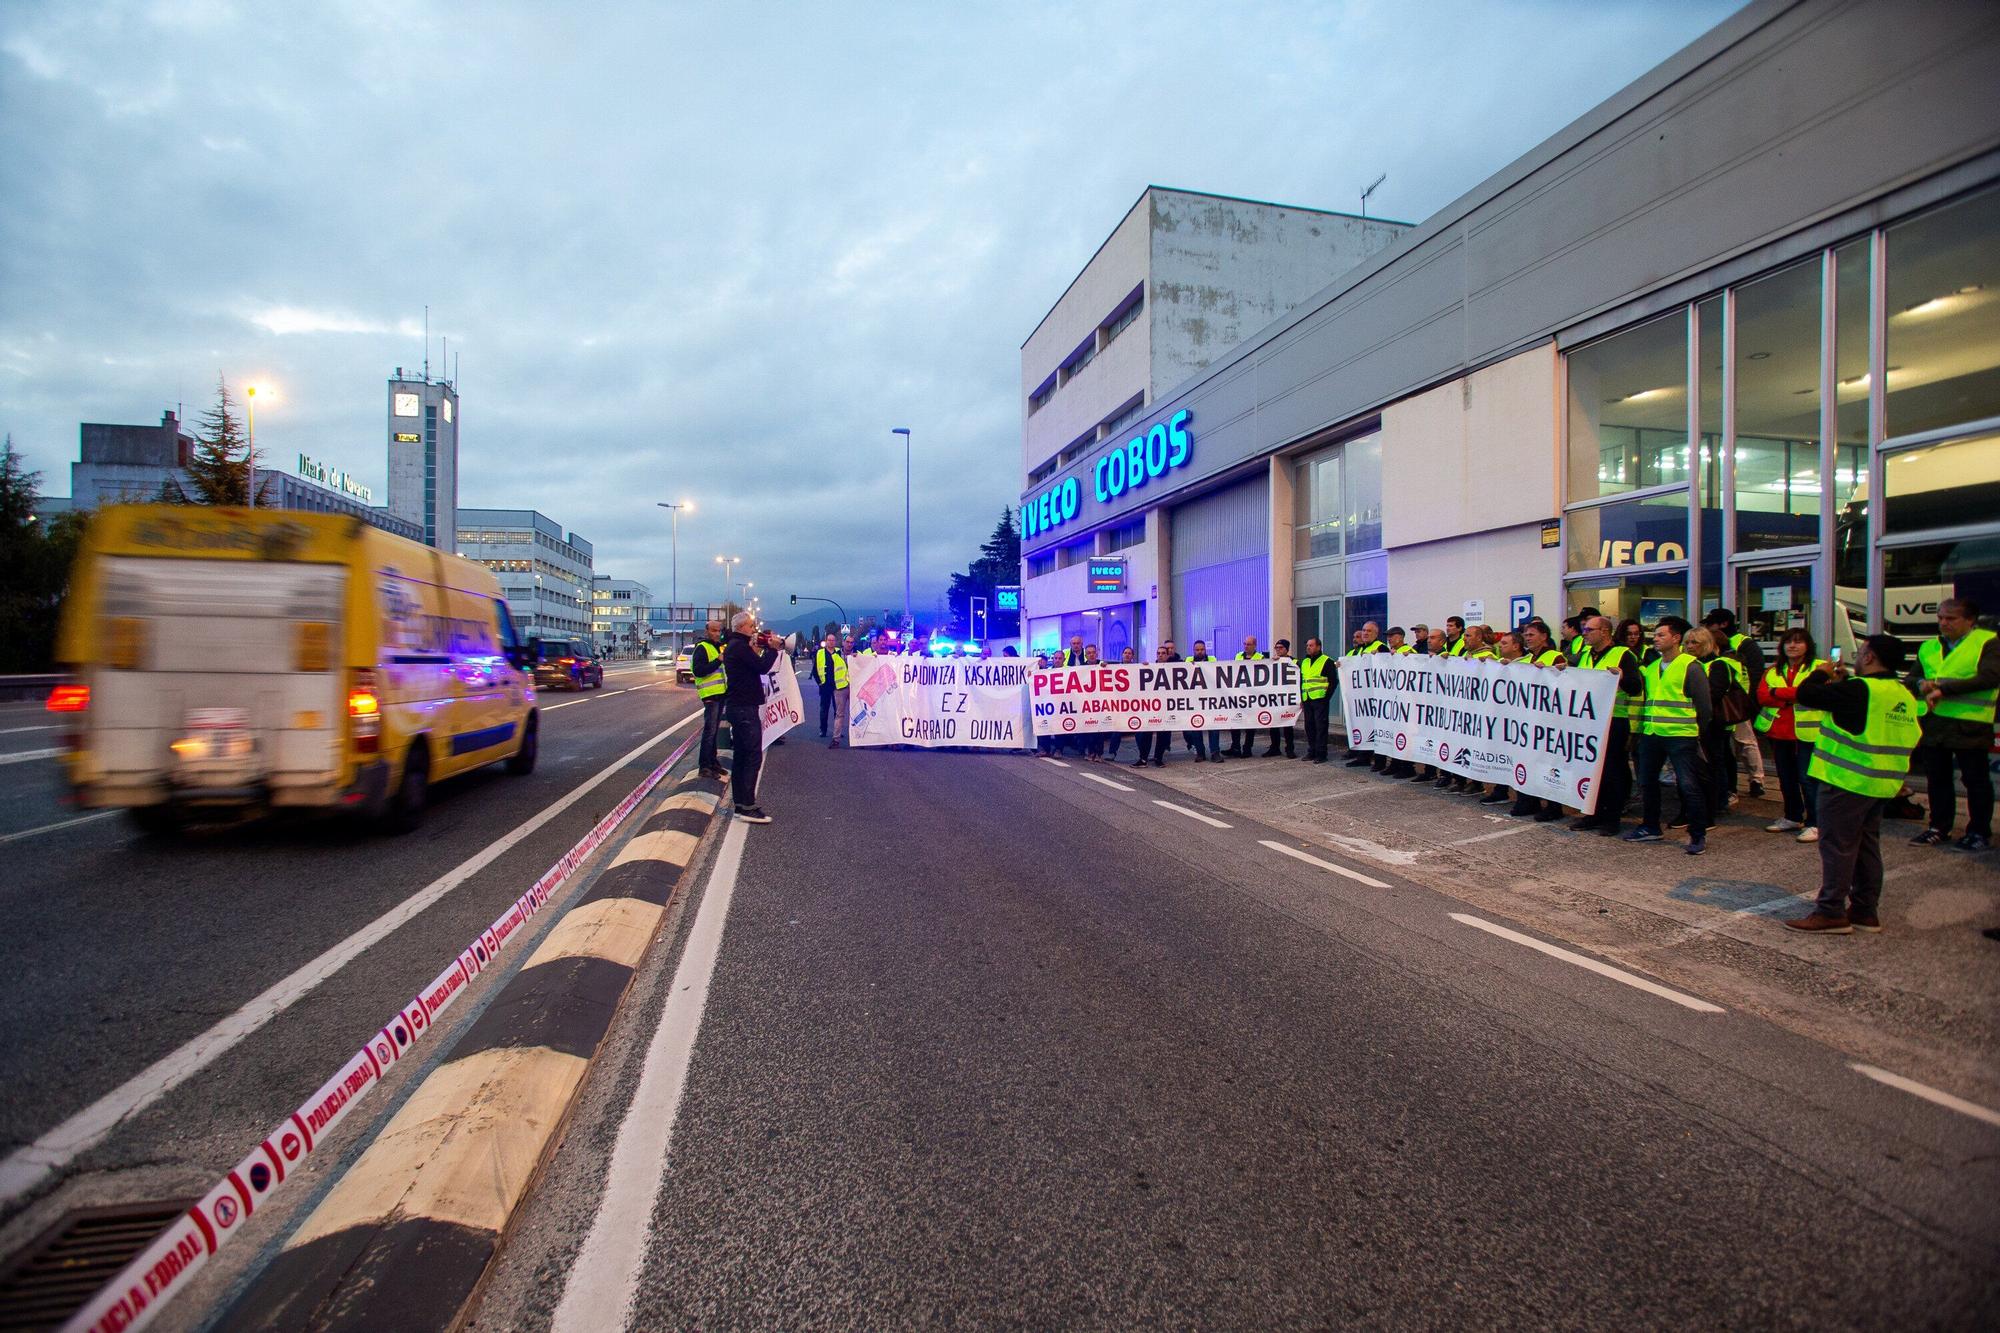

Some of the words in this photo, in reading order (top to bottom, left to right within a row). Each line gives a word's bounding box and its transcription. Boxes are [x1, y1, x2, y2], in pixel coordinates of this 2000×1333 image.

[299, 453, 328, 482] Diario
[330, 467, 341, 488] de
[342, 472, 372, 500] Navarra
[1021, 477, 1080, 540] IVECO
[1095, 409, 1192, 502] COBOS
[1091, 567, 1122, 576] IVECO
[1512, 600, 1531, 628] P
[1895, 602, 1938, 616] IVE
[964, 665, 1028, 686] KASKARRIK
[1033, 669, 1130, 696] PEAJES
[1139, 667, 1208, 691] PARA
[1215, 662, 1297, 689] NADIE
[1035, 702, 1055, 716] NO
[1059, 701, 1077, 715] AL
[1081, 698, 1162, 713] ABANDONO
[1167, 697, 1194, 711] DEL
[1199, 692, 1297, 710] TRANSPORTE
[1352, 669, 1362, 689] EL
[1436, 672, 1489, 702] NAVARRO
[1492, 678, 1563, 716] CONTRA
[1568, 689, 1596, 720] LA
[901, 717, 956, 740] GARRAIO
[970, 719, 1014, 741] DUINA
[1415, 703, 1482, 739] TRIBUTARIA
[1486, 715, 1497, 740] Y
[1503, 717, 1529, 748] LOS
[1533, 725, 1598, 763] PEAJES
[306, 1086, 347, 1134] POLICIA
[343, 1062, 374, 1097] FORAL
[144, 1233, 203, 1298] FORAL
